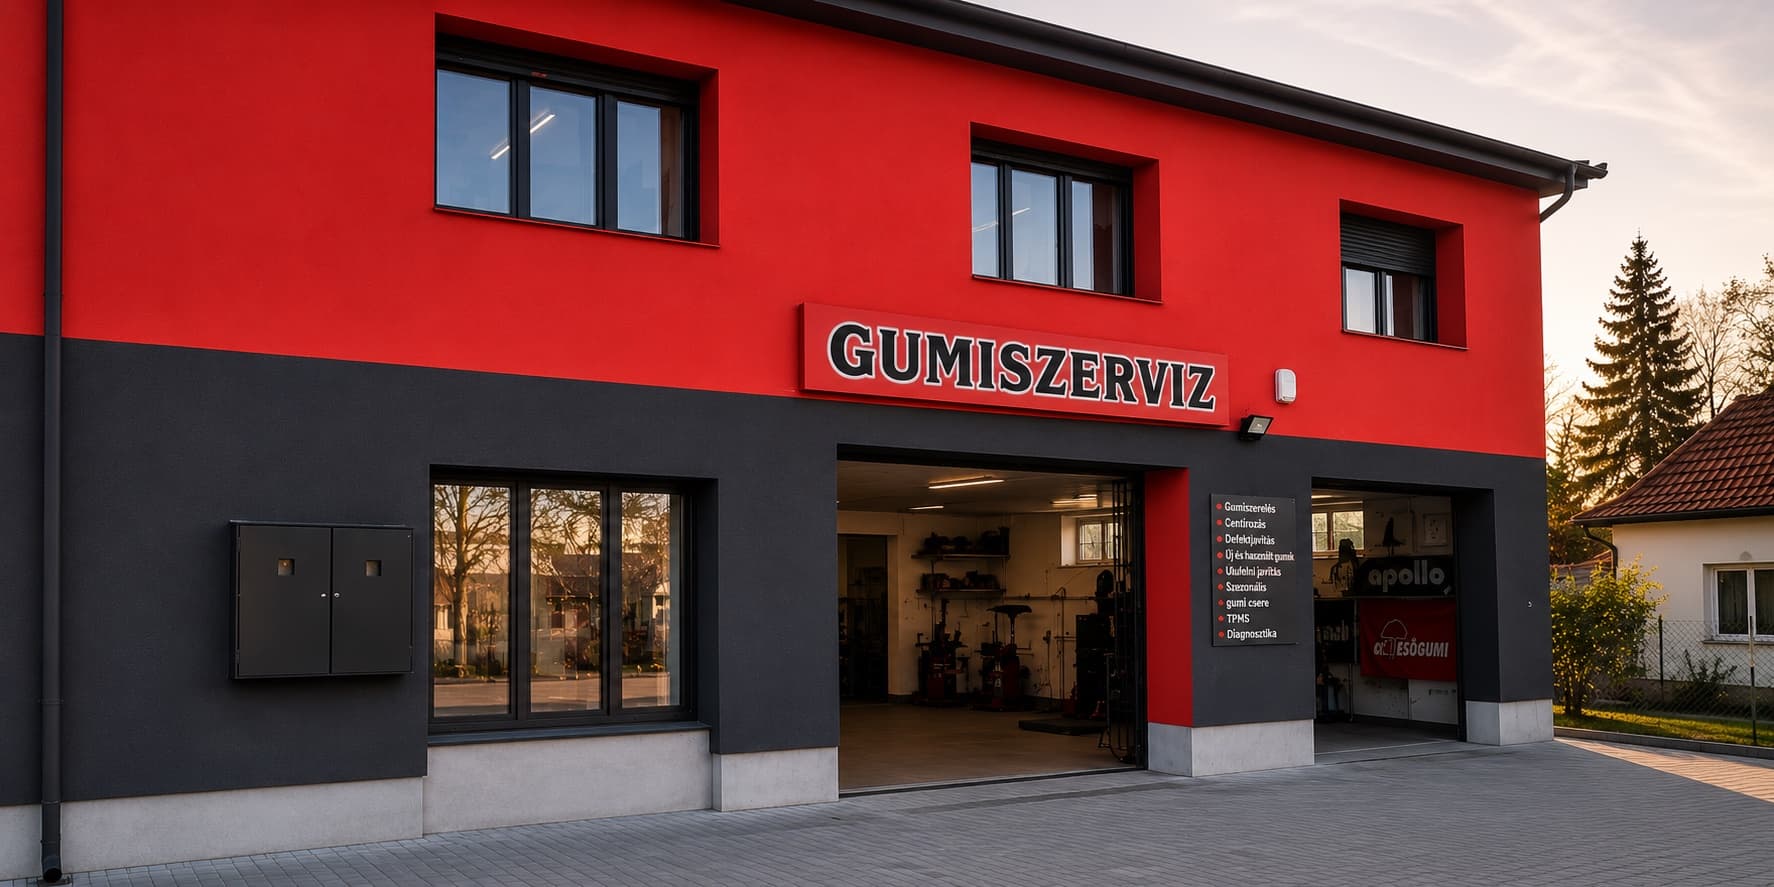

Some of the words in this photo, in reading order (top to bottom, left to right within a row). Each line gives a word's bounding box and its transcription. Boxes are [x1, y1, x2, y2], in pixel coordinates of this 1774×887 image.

[827, 320, 1217, 412] GUMISZERVIZ
[1235, 549, 1244, 560] és
[1368, 559, 1445, 593] apollo
[1225, 596, 1247, 610] gumi
[1248, 599, 1270, 608] csere
[1226, 613, 1251, 624] TPMS
[1226, 628, 1278, 641] Diagnosztika
